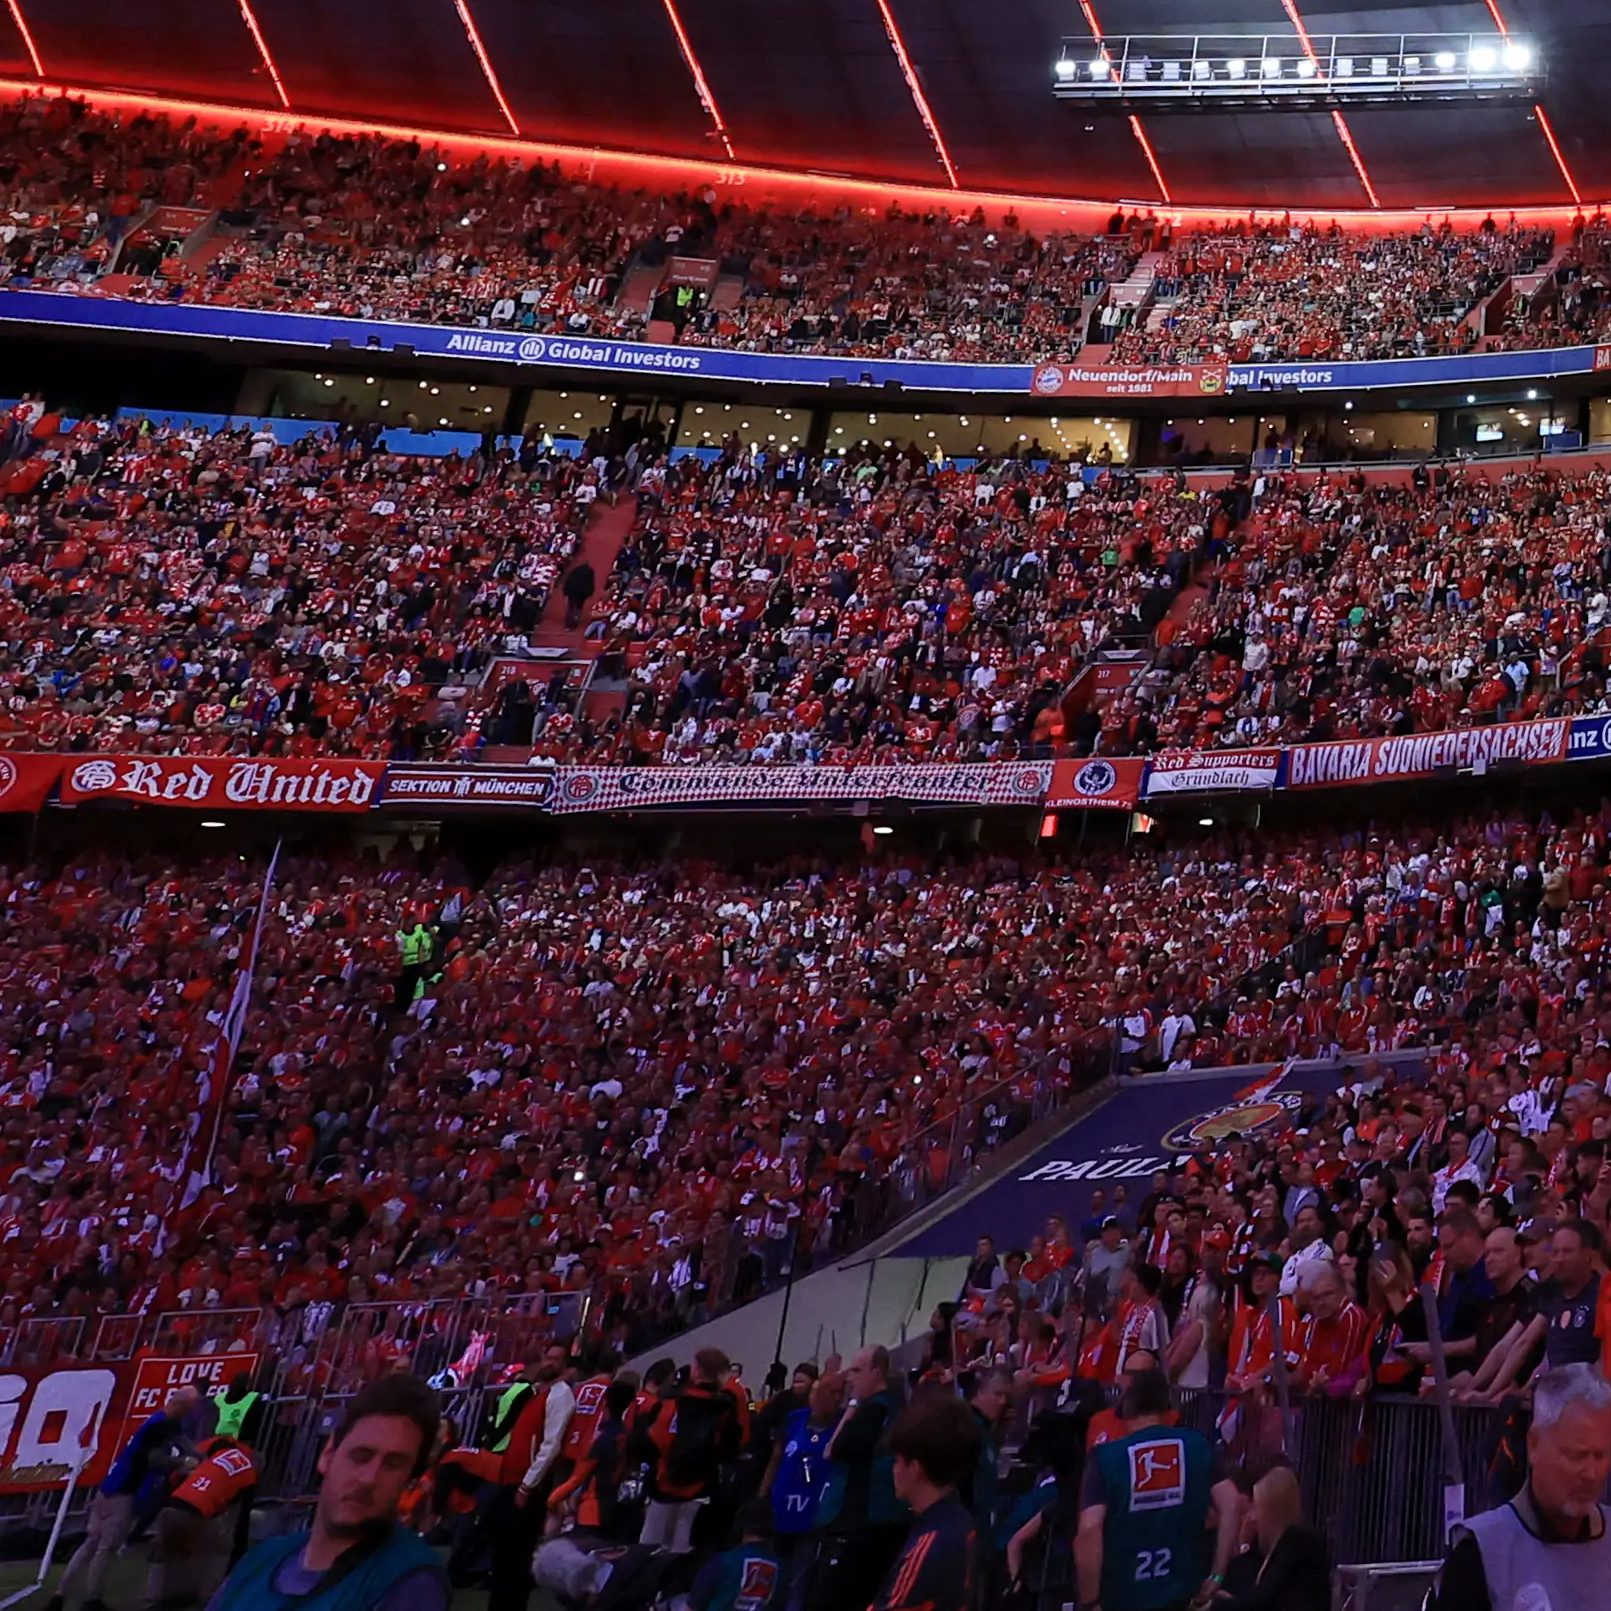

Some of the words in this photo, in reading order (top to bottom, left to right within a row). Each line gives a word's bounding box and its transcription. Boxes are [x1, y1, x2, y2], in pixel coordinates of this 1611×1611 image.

[447, 334, 516, 355] Allianz
[548, 343, 611, 362] Global
[613, 348, 701, 369] Investors
[1068, 367, 1193, 383] Neuendorf/Main
[1153, 755, 1184, 771] Red
[1188, 753, 1275, 769] Supporters
[1291, 742, 1373, 785] BAVARIA
[116, 760, 213, 800] Red
[225, 762, 375, 805] United
[389, 778, 450, 794] SEKTION
[473, 778, 544, 795] MÜNCHEN
[1171, 769, 1250, 788] Gründlach
[166, 1361, 225, 1385] LOVE
[787, 1494, 810, 1512] TV
[1135, 1547, 1172, 1581] 22
